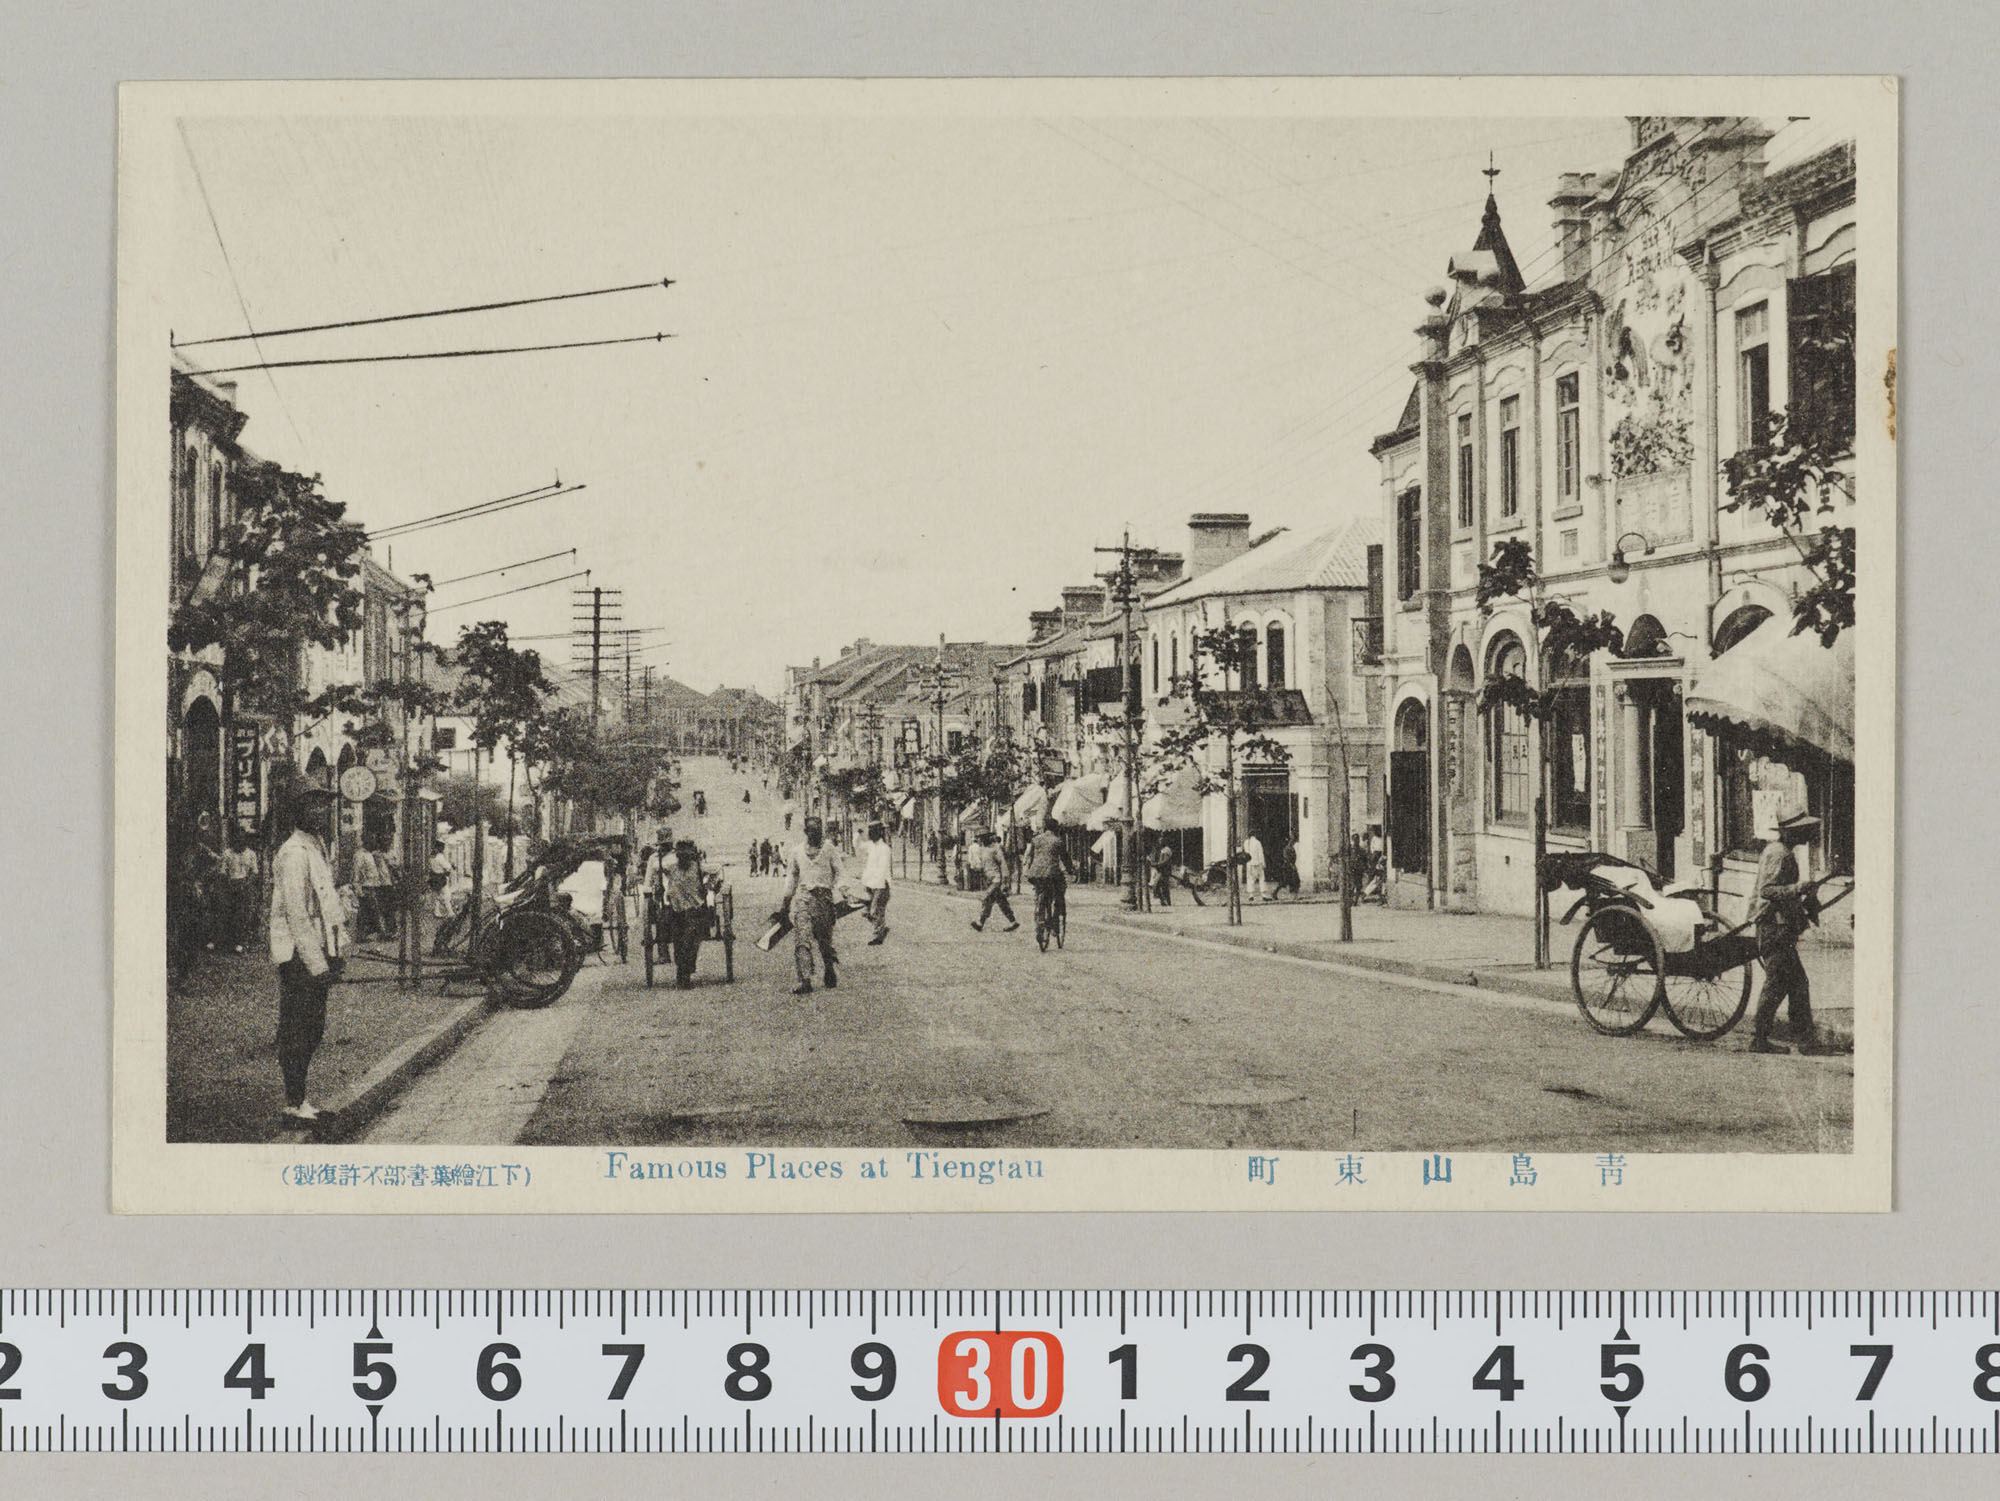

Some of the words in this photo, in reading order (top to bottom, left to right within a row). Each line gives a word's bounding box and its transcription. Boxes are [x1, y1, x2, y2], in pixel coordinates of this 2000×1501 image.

[604, 1151, 728, 1181] Famous
[745, 1151, 844, 1180] Places
[860, 1158, 889, 1180] at
[906, 1151, 1044, 1185] Tiengtau
[101, 1342, 149, 1401] 3
[223, 1343, 275, 1400] 4
[352, 1343, 397, 1401] 5
[476, 1343, 522, 1401] 6
[602, 1343, 645, 1400] 7
[724, 1342, 772, 1401] 8
[850, 1343, 897, 1401] 9
[954, 1337, 1048, 1411] 30
[1108, 1344, 1138, 1400] 1
[1225, 1344, 1271, 1401] 2
[1348, 1344, 1396, 1402] 3
[1472, 1345, 1524, 1401] 4
[1600, 1344, 1644, 1401] 5
[1724, 1344, 1771, 1402] 6
[1850, 1344, 1894, 1400] 7
